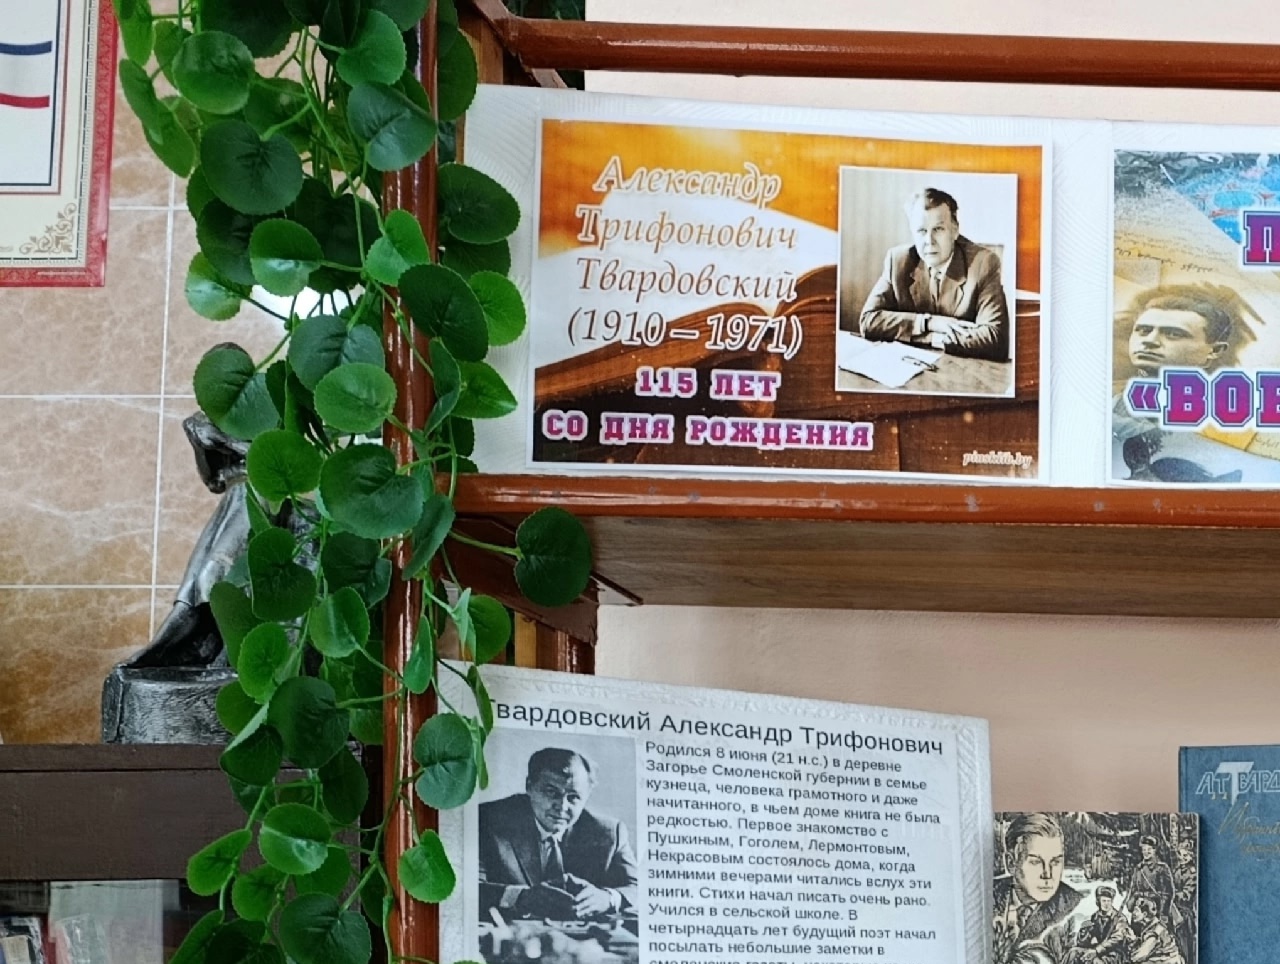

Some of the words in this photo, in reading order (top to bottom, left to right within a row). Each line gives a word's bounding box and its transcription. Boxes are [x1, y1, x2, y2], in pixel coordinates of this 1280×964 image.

[595, 158, 781, 206] Александр
[577, 205, 797, 253] Трифонович
[577, 257, 798, 302] Твардовский
[638, 368, 697, 396] 115
[712, 370, 779, 399] ЛЕТ
[545, 414, 586, 440] СО
[604, 415, 673, 442] ДНЯ
[689, 419, 872, 448] РОЖДЕНИЯ
[492, 699, 650, 730] вардовский
[659, 715, 792, 746] Александр
[646, 741, 710, 757] Родился
[716, 747, 725, 758] 8
[730, 750, 767, 762] июня
[772, 751, 794, 765] (21
[798, 756, 828, 768] н.с.)
[833, 758, 840, 767] в
[844, 760, 902, 772] деревне
[646, 760, 707, 776] Загорье
[712, 764, 801, 781] Смоленской
[806, 772, 870, 787] губернии
[874, 778, 882, 787] в
[886, 779, 927, 790] семье
[648, 798, 745, 814] начитанного,
[751, 804, 758, 812] в
[764, 804, 799, 815] чьем
[803, 807, 839, 818] доме
[844, 810, 880, 820] книга
[885, 812, 900, 822] не
[905, 812, 940, 824] была
[716, 784, 784, 797] человека
[789, 788, 867, 802] грамотного
[872, 794, 880, 803] и
[884, 795, 918, 806] даже
